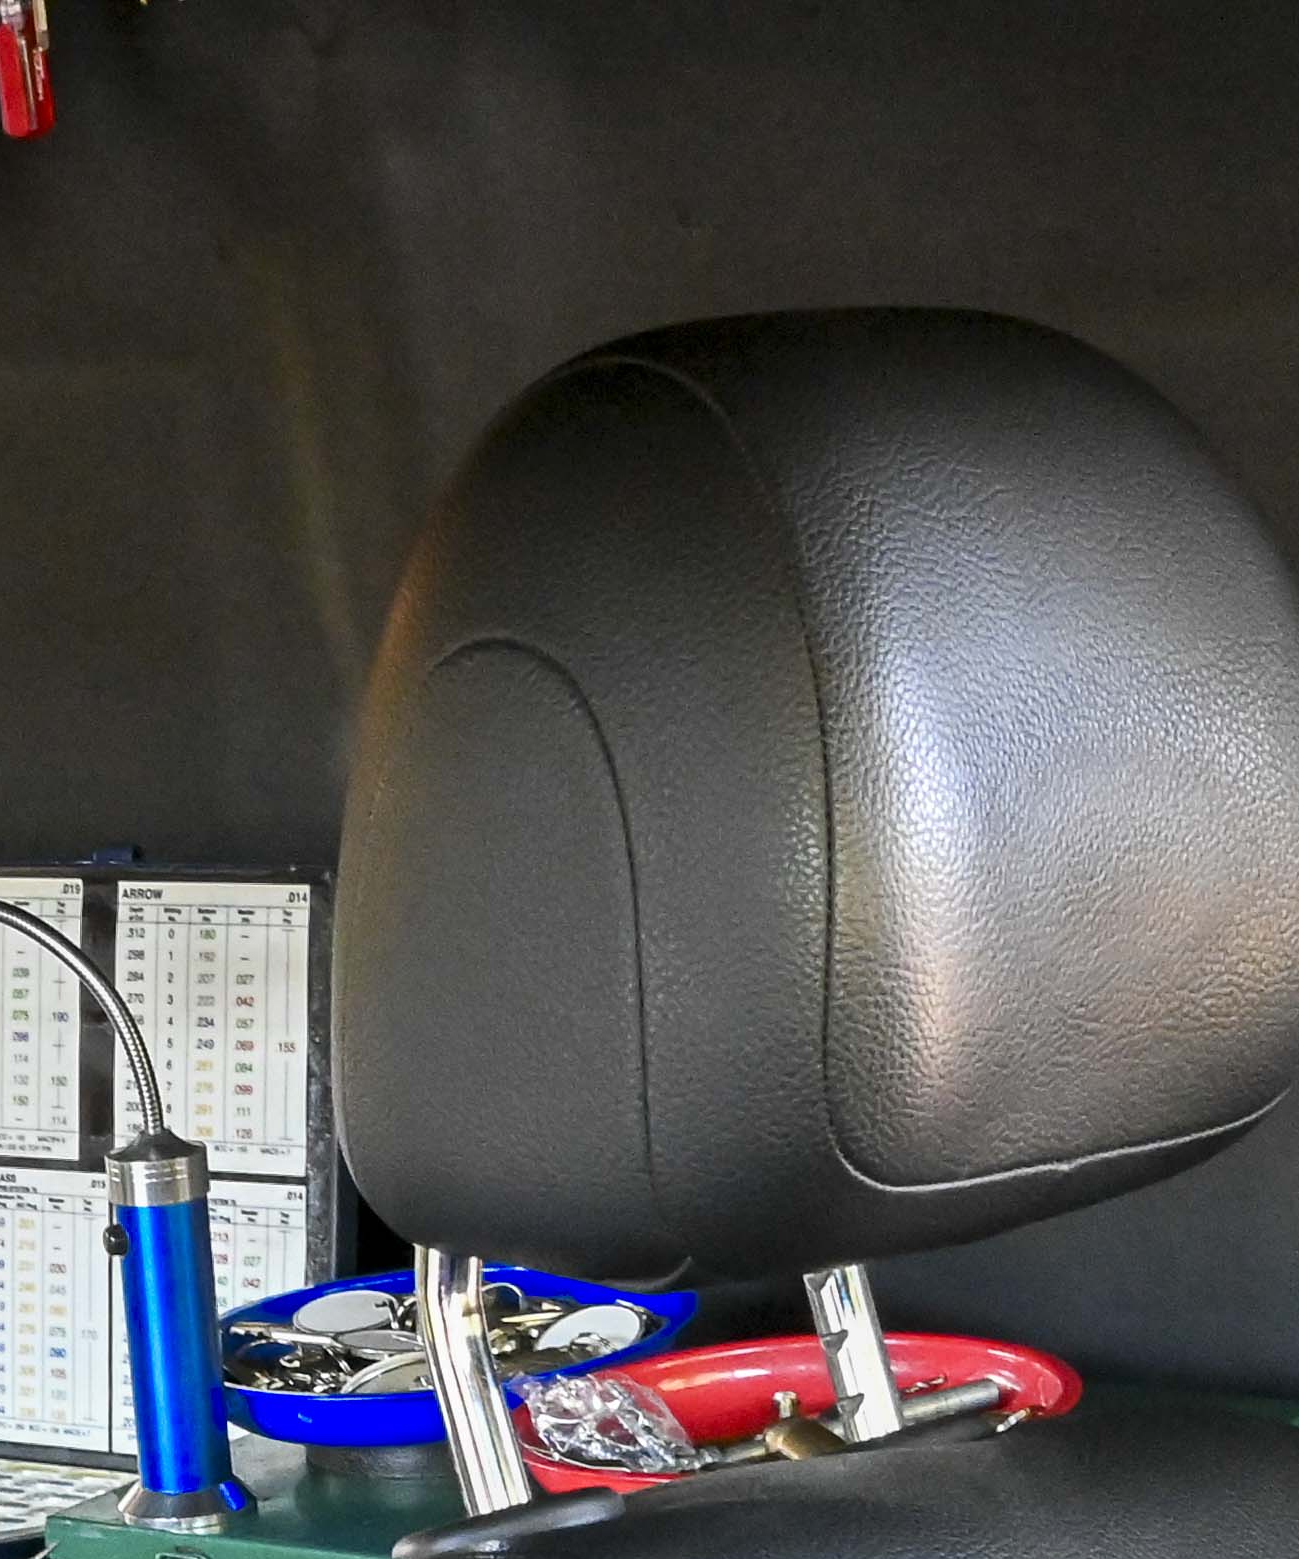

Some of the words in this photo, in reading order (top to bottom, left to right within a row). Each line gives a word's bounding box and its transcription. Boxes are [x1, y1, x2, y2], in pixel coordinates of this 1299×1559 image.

[122, 889, 163, 900] ARROW
[168, 928, 175, 939] 0
[167, 994, 173, 1005] 3
[167, 1017, 174, 1026] 4
[166, 1060, 172, 1070] 6
